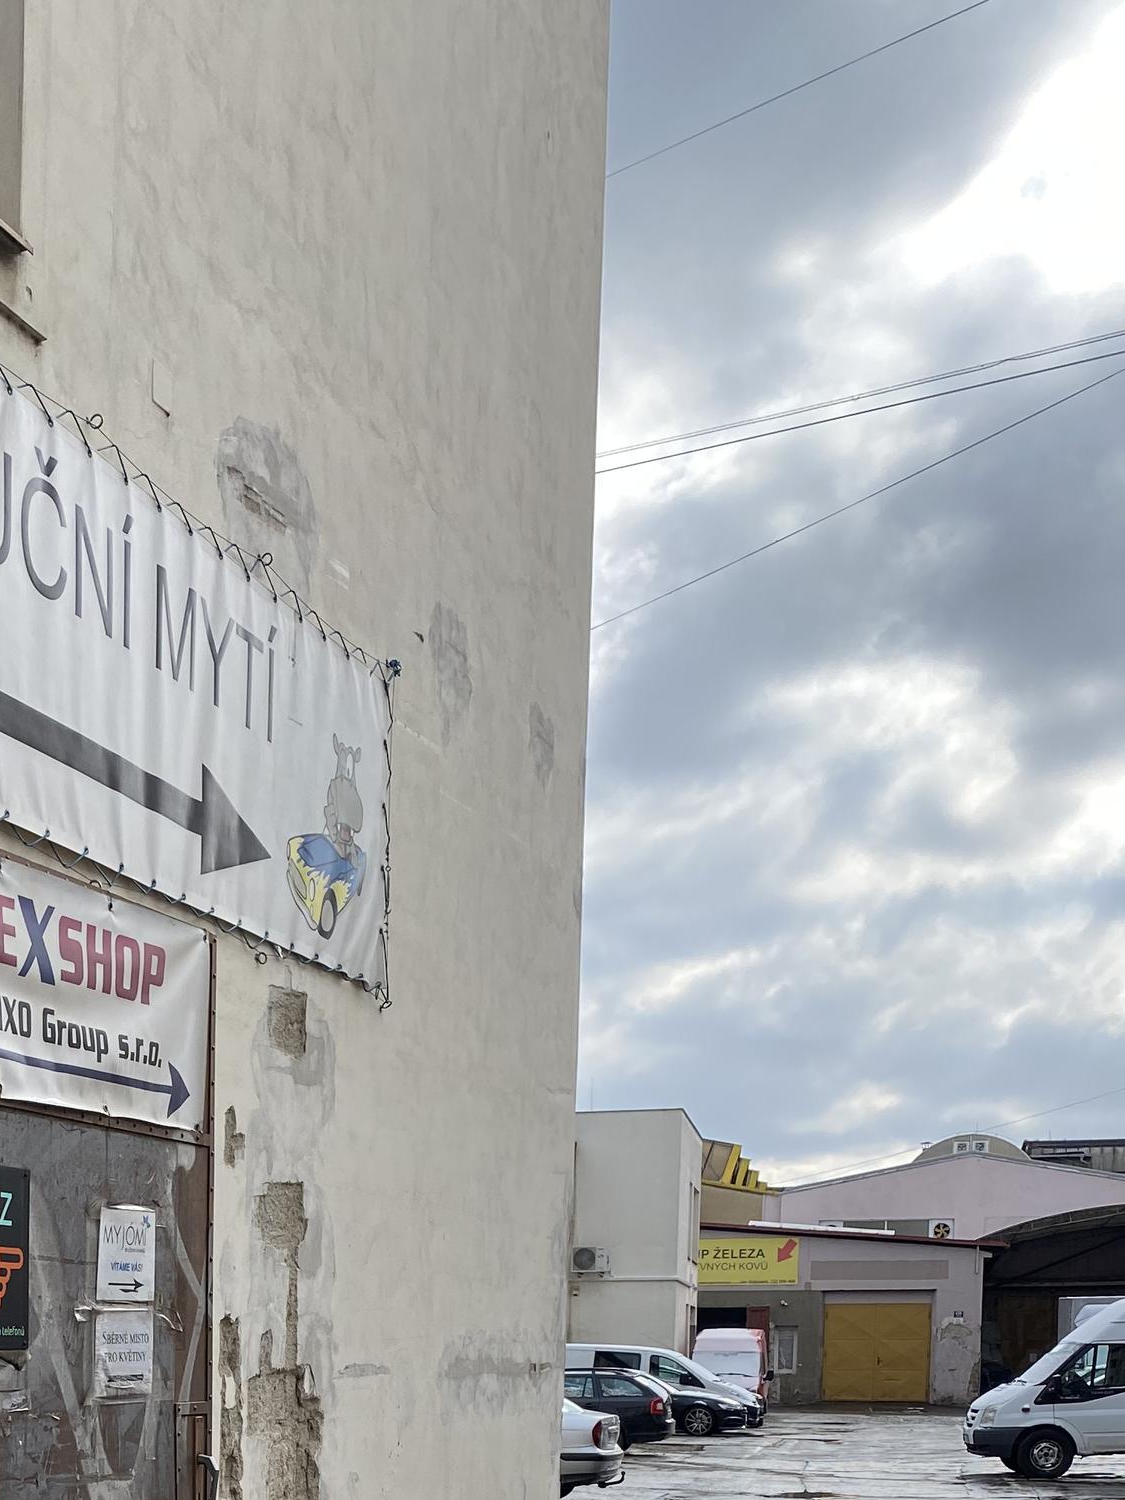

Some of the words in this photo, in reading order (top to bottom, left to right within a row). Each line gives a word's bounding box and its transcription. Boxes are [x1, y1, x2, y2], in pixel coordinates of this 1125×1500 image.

[154, 563, 277, 743] MYTÍ
[42, 1007, 109, 1063] Group
[118, 1033, 163, 1068] s.r.o.
[713, 1246, 765, 1259] ŽELEZA
